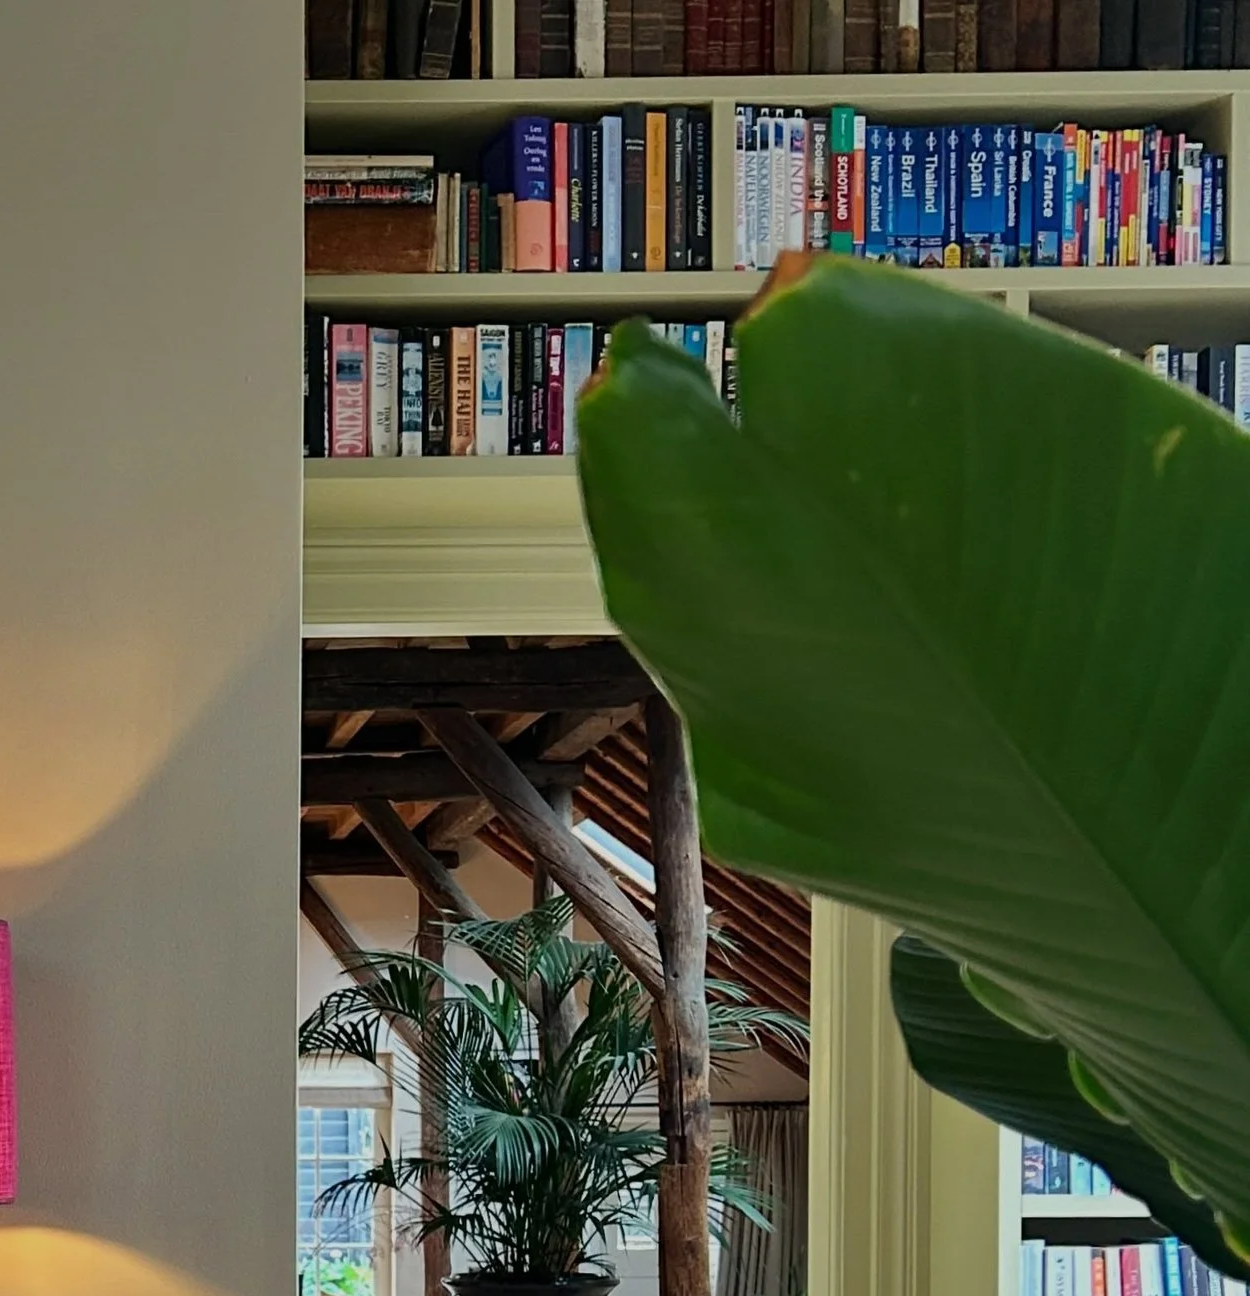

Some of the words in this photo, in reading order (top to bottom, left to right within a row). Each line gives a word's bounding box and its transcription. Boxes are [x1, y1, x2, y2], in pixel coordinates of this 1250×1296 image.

[675, 118, 683, 142] Stefan
[675, 144, 683, 182] Hertmans
[814, 134, 826, 186] Scotland
[871, 156, 881, 182] New
[902, 154, 915, 198] Brazil
[968, 151, 986, 198] Spain
[994, 151, 1004, 165] Sri
[1008, 156, 1016, 184] British
[1022, 150, 1032, 182] Croatia
[746, 154, 756, 202] NAPELS
[790, 156, 804, 216] INDIA
[837, 156, 848, 220] SCHOTLAND
[925, 154, 938, 214] Thailand
[994, 167, 1004, 196] Lanka
[1044, 166, 1056, 218] France
[1204, 178, 1212, 216] SYDNEY
[572, 178, 582, 222] Charlotte
[760, 155, 769, 243] NOORWEGEN
[814, 190, 824, 208] the
[871, 185, 882, 232] Zealand
[1008, 185, 1016, 226] Columbia
[814, 212, 824, 238] Best
[376, 352, 387, 390] GREY
[457, 355, 470, 384] THE
[336, 384, 362, 454] PEKING
[456, 390, 470, 416] HAJ
